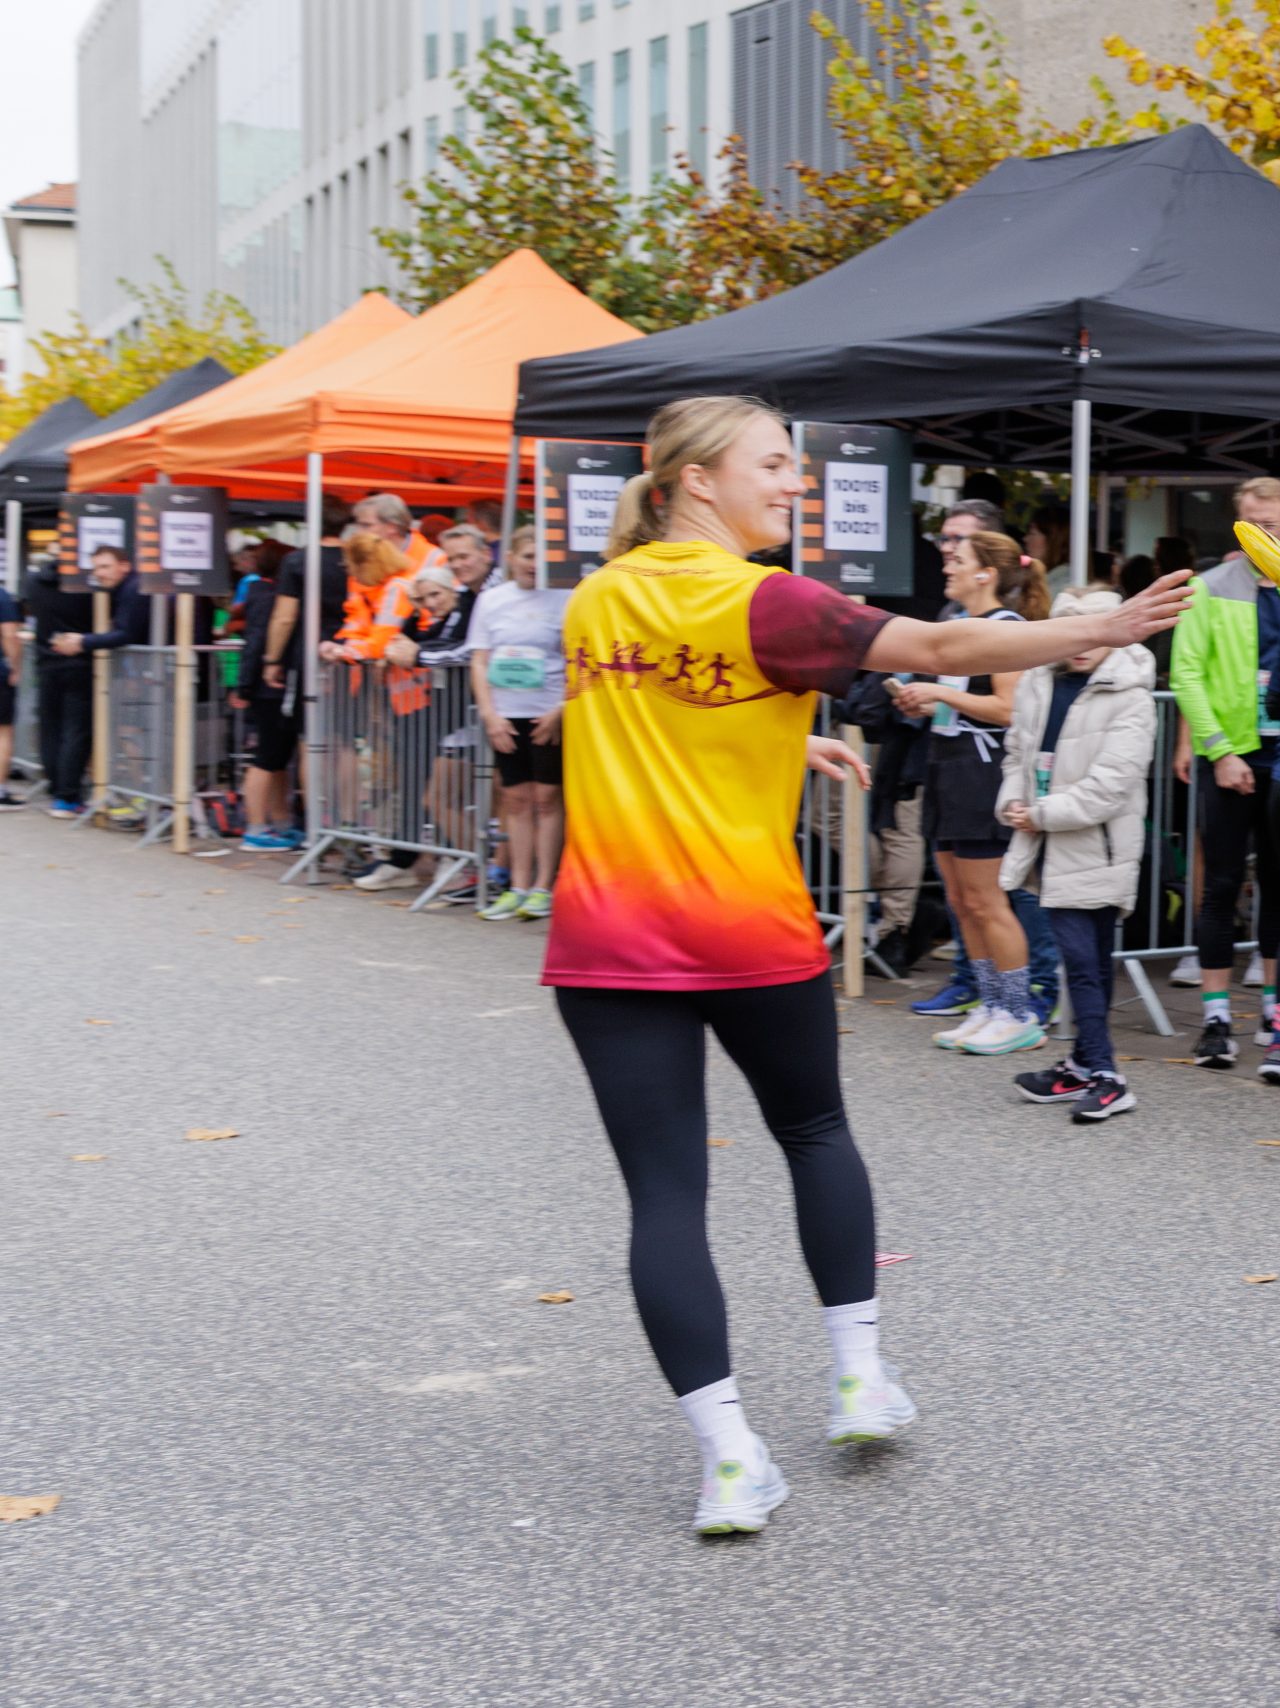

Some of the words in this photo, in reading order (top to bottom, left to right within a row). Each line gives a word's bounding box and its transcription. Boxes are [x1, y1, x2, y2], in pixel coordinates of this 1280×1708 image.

[832, 478, 881, 494] 10015
[584, 508, 609, 520] bis
[842, 499, 869, 514] bis
[573, 525, 612, 538] 1002
[832, 520, 881, 535] 10021
